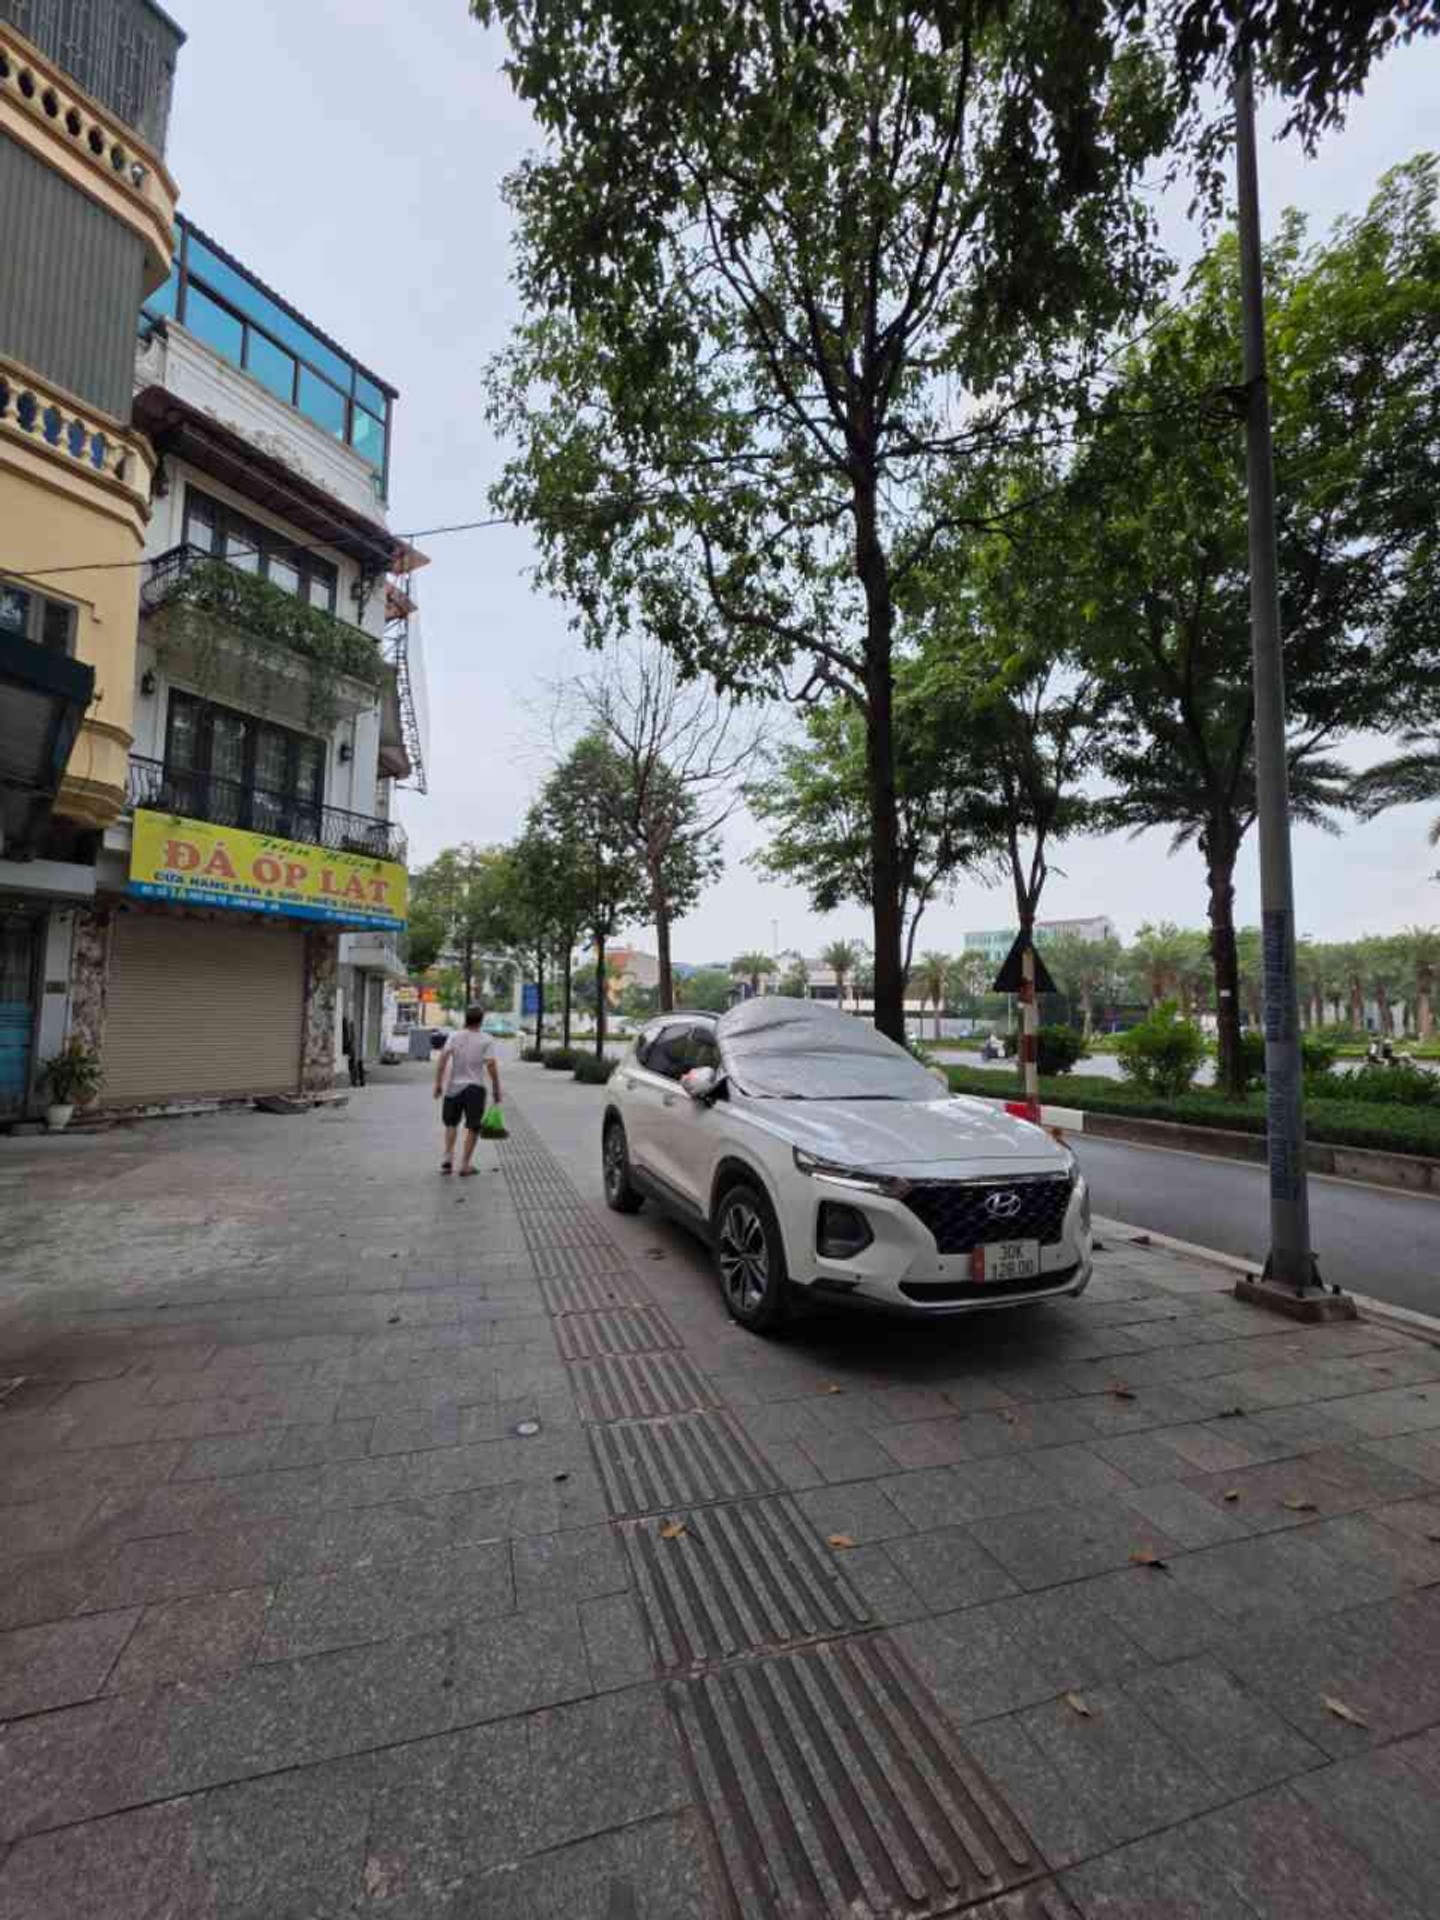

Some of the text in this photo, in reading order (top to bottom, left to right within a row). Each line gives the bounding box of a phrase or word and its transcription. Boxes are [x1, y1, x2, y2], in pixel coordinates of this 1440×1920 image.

[165, 839, 237, 879] ĐÁ
[252, 852, 309, 889] ỐP
[320, 868, 389, 904] LÁT
